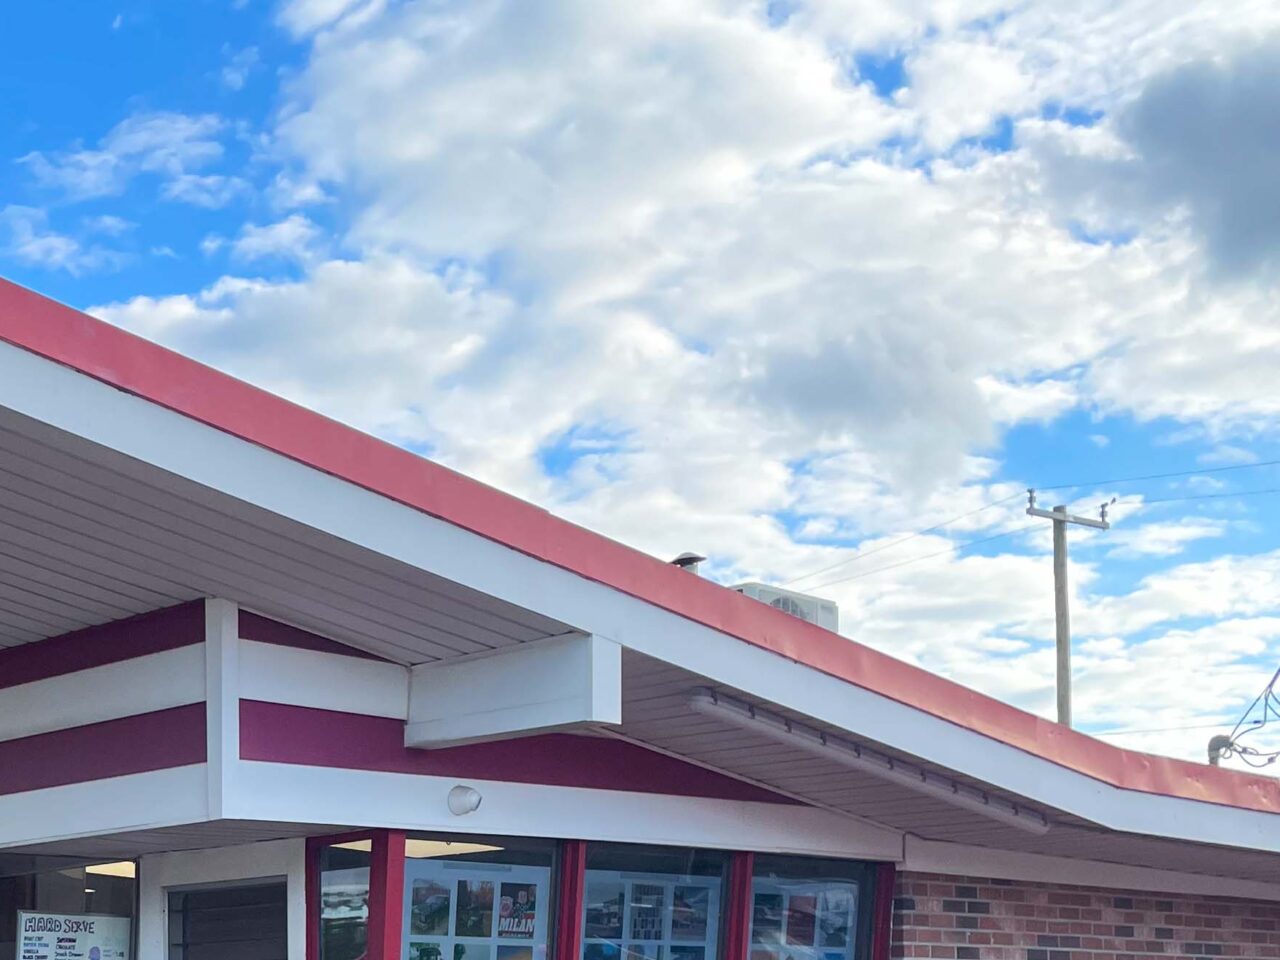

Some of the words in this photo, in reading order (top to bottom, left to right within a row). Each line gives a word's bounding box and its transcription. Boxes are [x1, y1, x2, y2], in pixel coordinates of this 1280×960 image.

[24, 916, 62, 933] HARD
[63, 919, 95, 934] SERVE
[498, 917, 536, 933] MILAN
